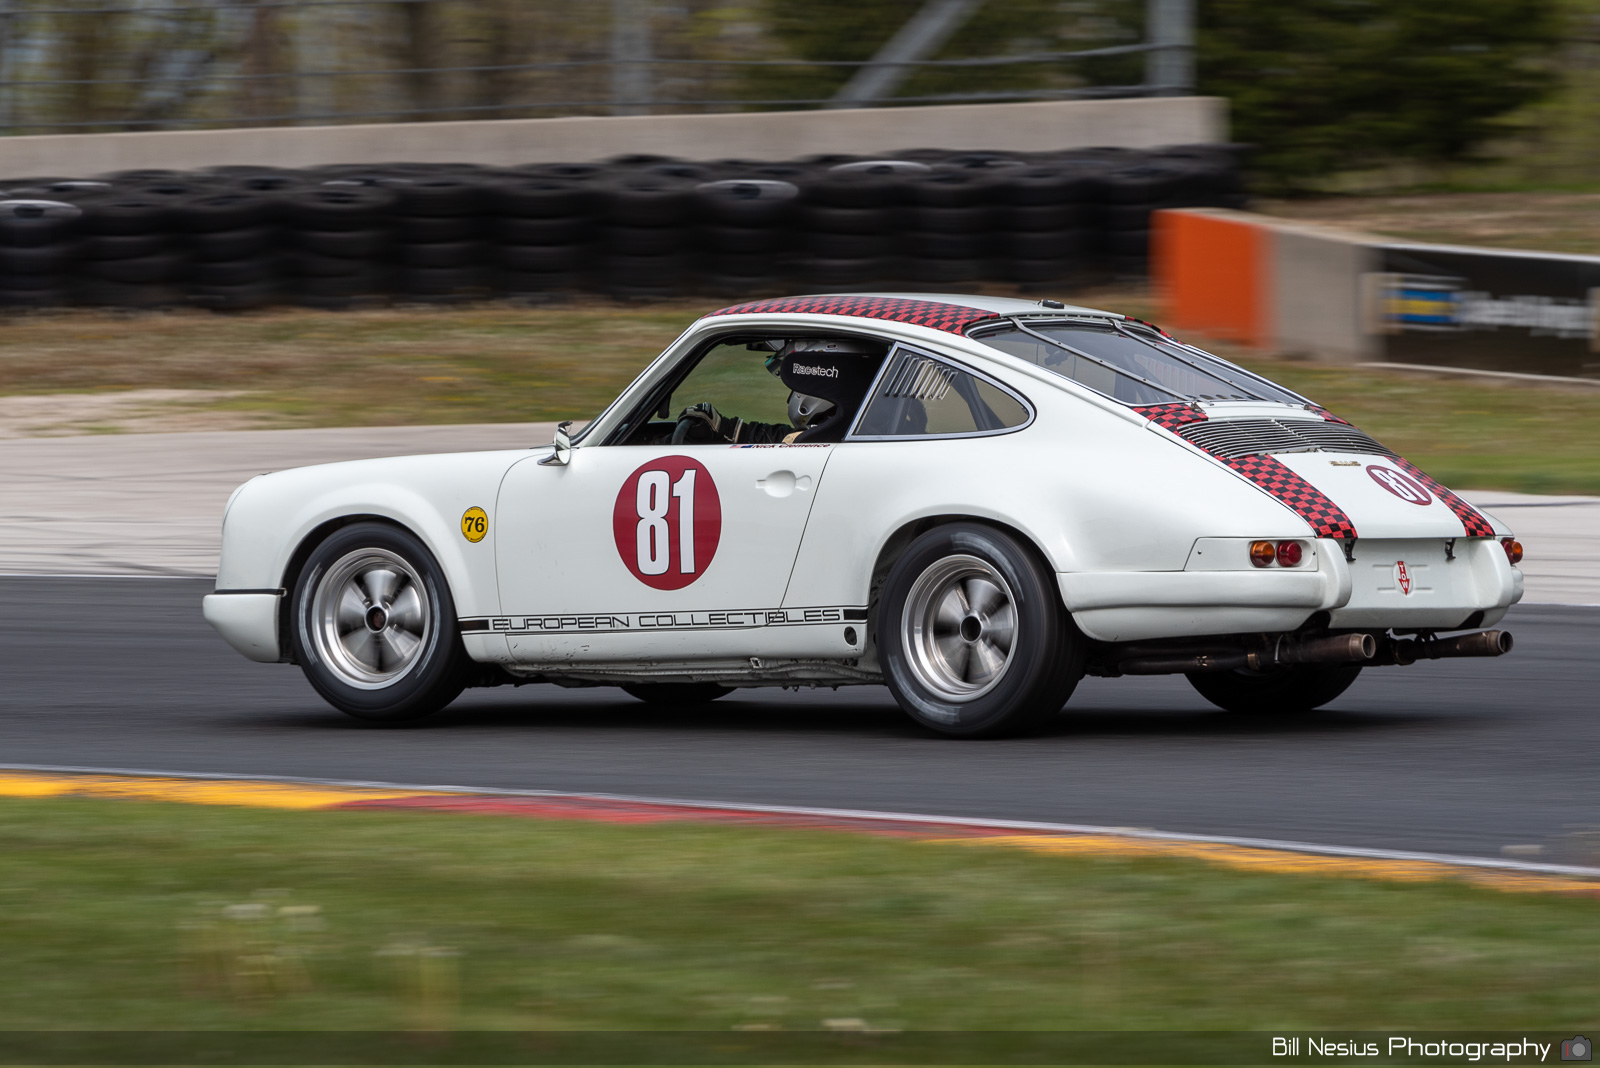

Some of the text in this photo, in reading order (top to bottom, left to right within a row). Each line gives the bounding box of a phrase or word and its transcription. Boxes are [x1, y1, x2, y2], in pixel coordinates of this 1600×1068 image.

[793, 363, 839, 378] Racetech
[1370, 468, 1430, 502] 81
[464, 516, 485, 533] 76
[636, 469, 698, 576] 81
[1399, 564, 1409, 589] TOW
[492, 609, 841, 630] EUROPEAN COLLECTIBLES
